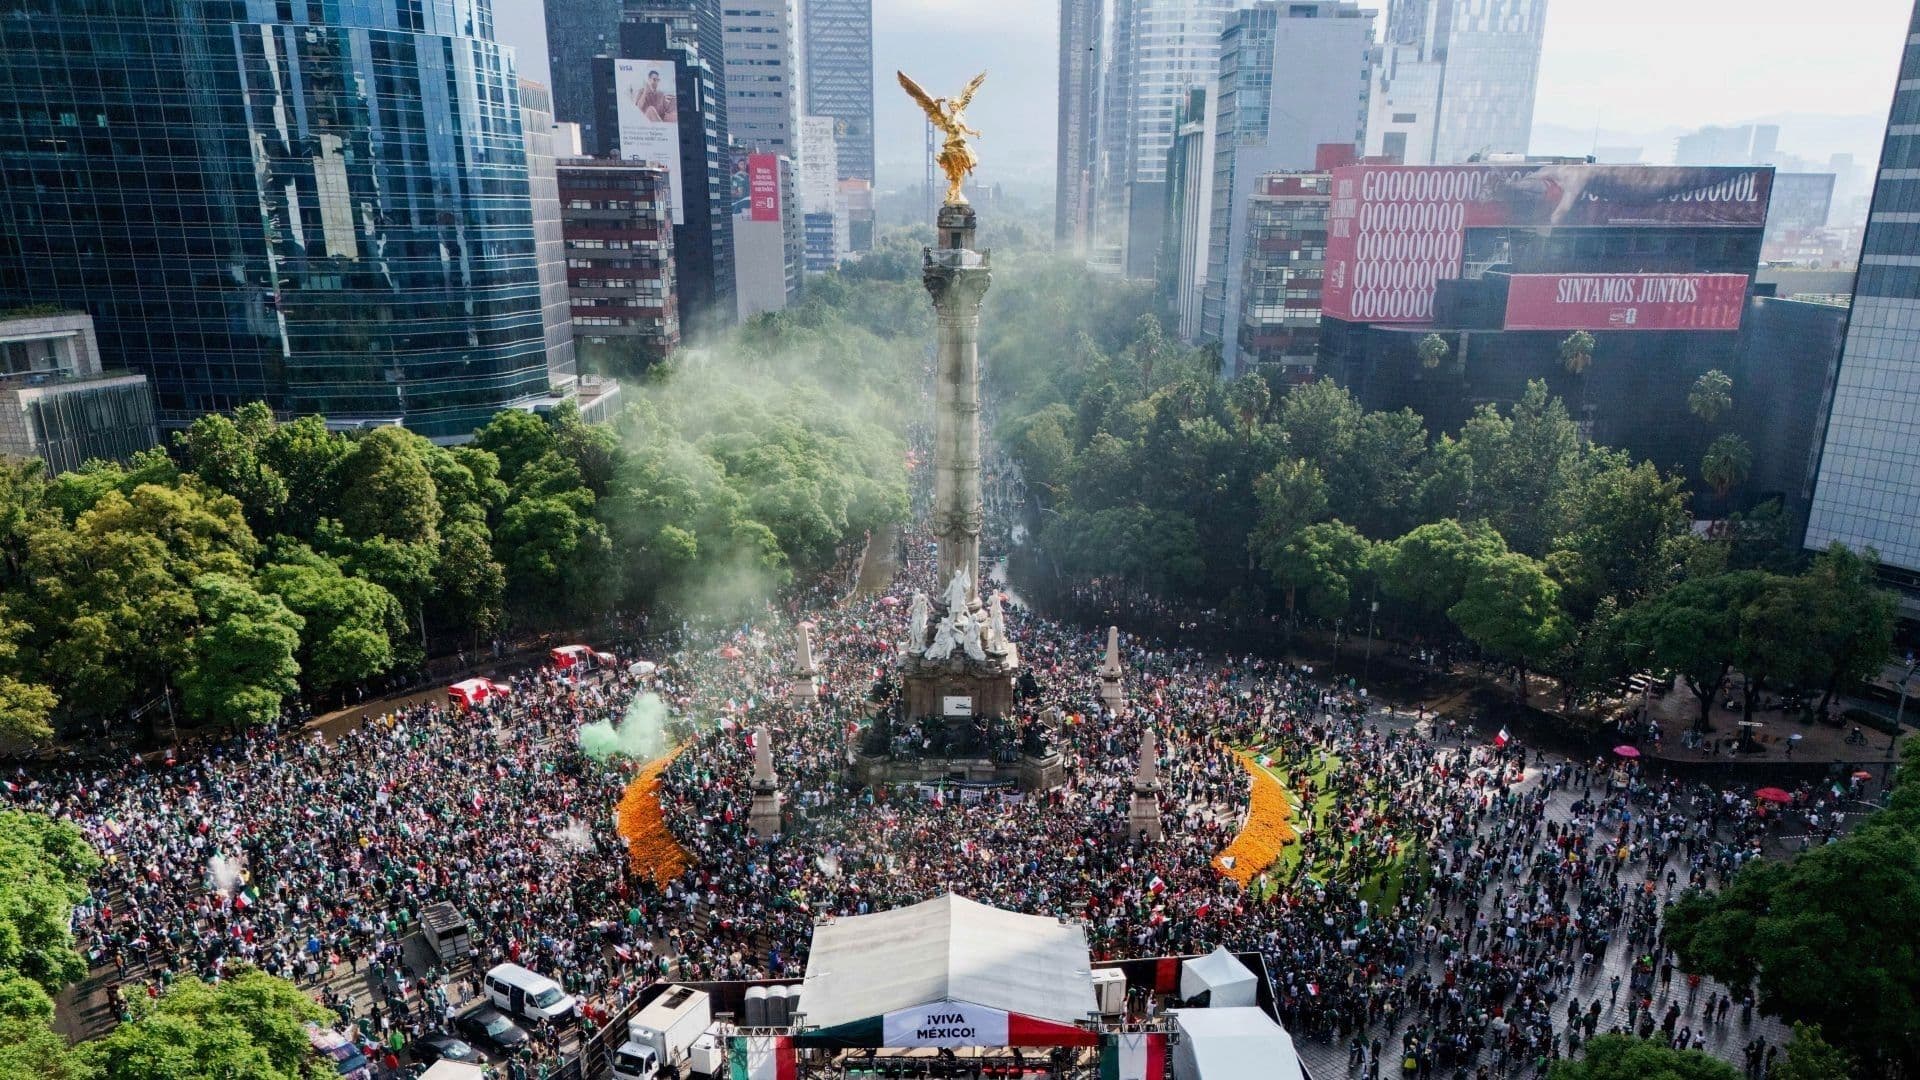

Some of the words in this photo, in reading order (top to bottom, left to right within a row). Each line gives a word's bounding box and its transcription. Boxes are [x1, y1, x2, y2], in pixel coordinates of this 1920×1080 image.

[1556, 277, 1636, 303] SINTAMOS
[1637, 277, 1699, 303] JUNTOS
[927, 1013, 965, 1025] ¡VIVA
[917, 1027, 976, 1039] MÉXICO!
